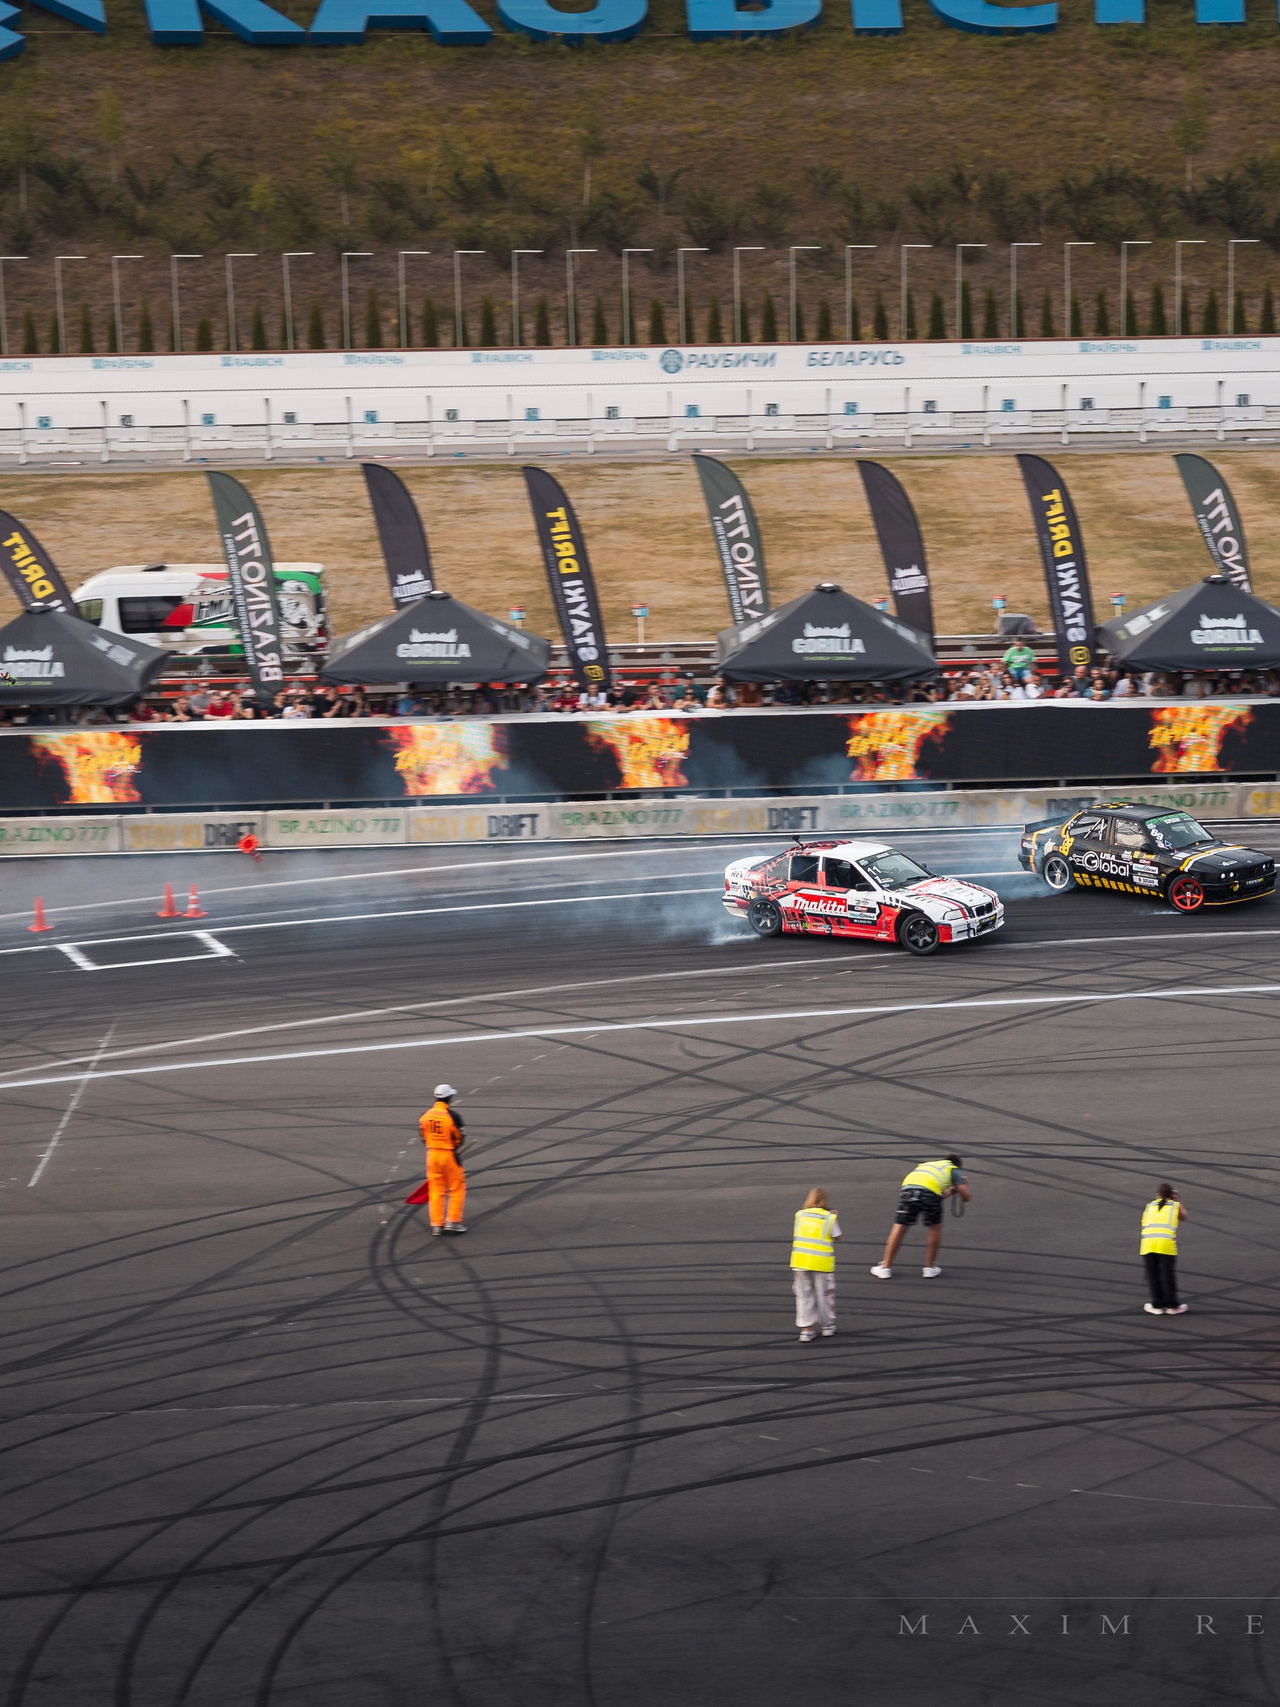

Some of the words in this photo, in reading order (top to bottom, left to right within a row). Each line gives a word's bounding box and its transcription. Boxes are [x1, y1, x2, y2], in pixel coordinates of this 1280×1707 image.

[687, 353, 777, 368] РАУБИЧИ
[807, 351, 905, 366] БЕЛАРУСЬ
[1190, 629, 1264, 644] GORILLA
[396, 644, 472, 657] GORILLA
[792, 639, 866, 653] GORILLA
[487, 814, 539, 837] DRIFT
[767, 807, 818, 829] DRIFT
[1151, 829, 1163, 840] 69
